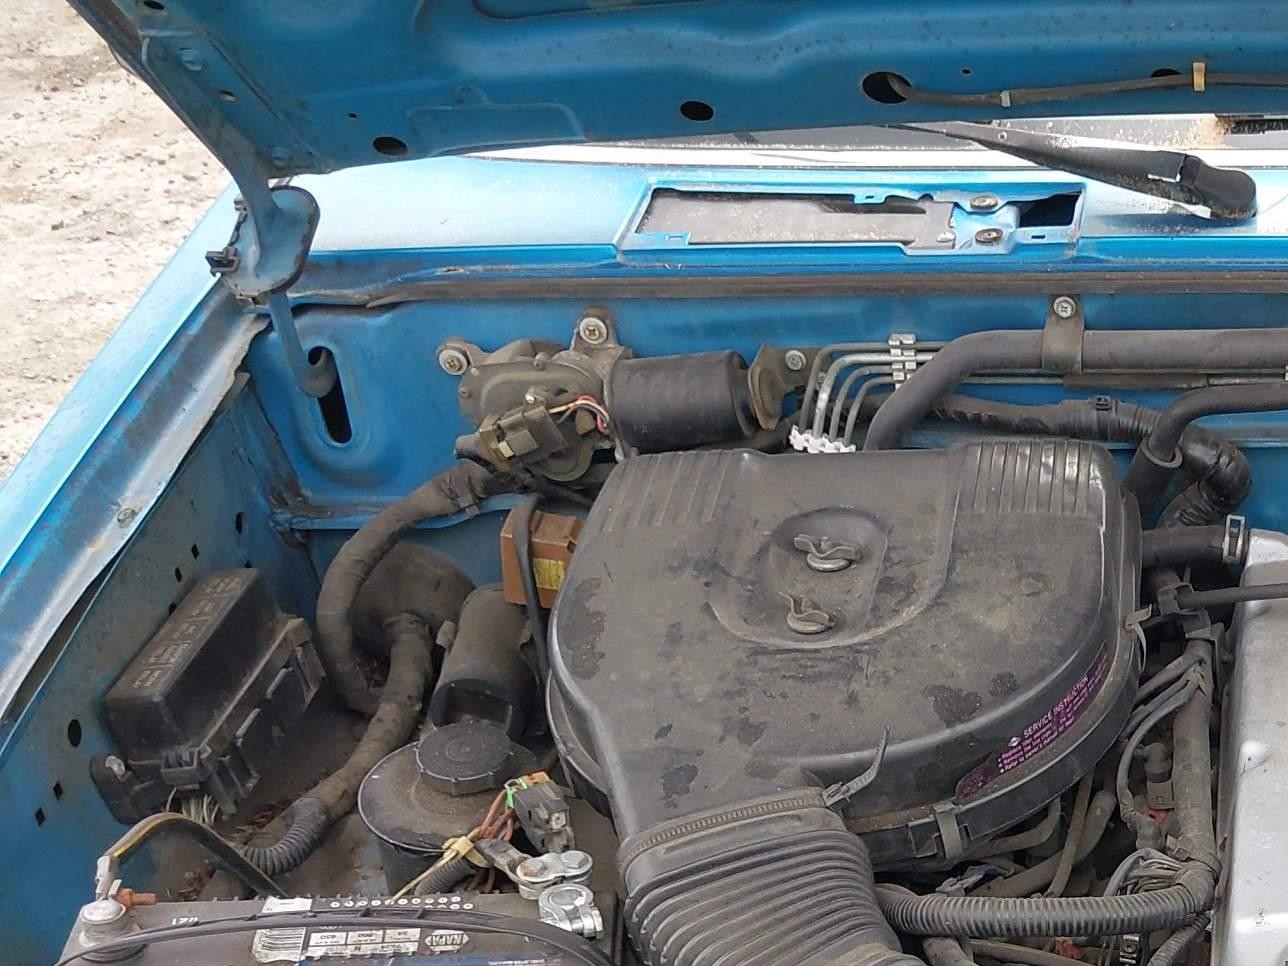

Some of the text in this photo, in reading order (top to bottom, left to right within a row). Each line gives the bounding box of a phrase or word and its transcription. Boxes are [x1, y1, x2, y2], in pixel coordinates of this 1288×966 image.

[1023, 712, 1053, 737] SERVICE
[1053, 675, 1089, 717] INSTRUCTION
[431, 934, 464, 946] NAPA
